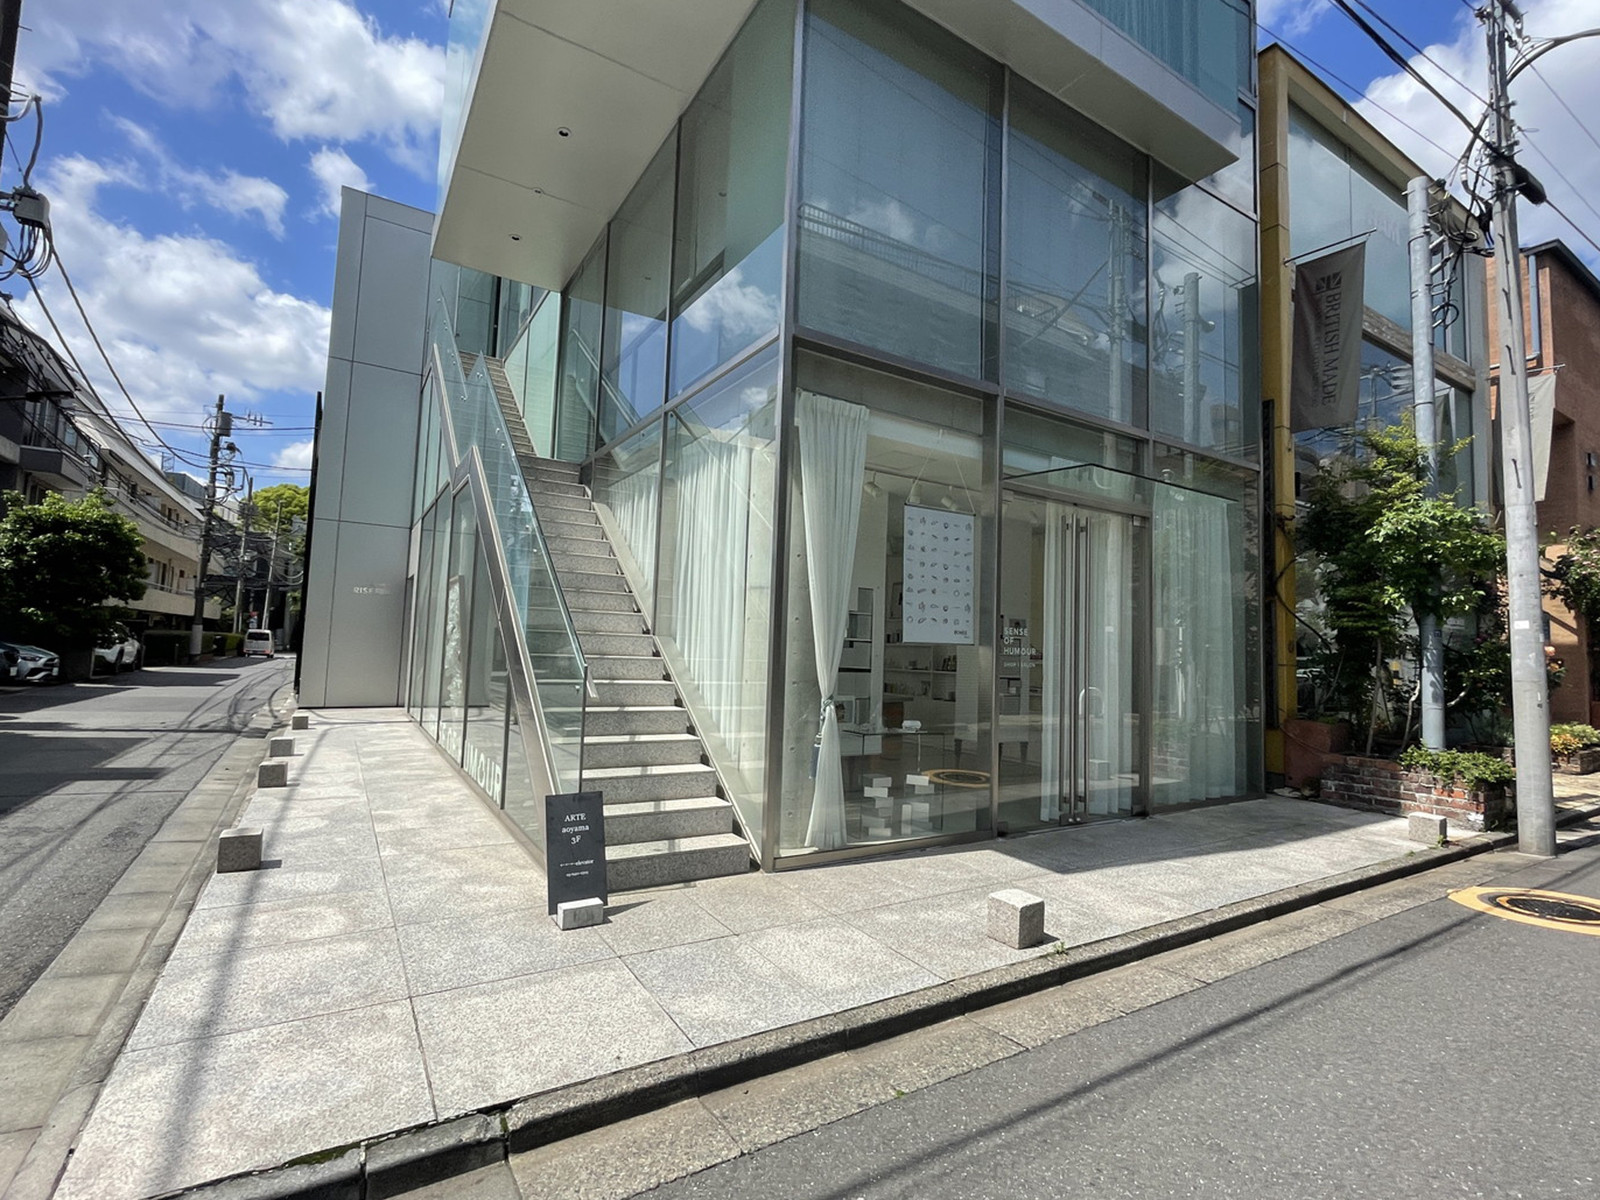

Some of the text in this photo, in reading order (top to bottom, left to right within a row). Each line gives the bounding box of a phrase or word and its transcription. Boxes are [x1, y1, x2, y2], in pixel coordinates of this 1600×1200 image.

[1321, 293, 1342, 407] BRITISH MADE
[1003, 627, 1028, 636] SENSE
[1003, 637, 1014, 645] OF
[1003, 647, 1036, 656] HUMOUR
[564, 813, 586, 822] ARTE
[561, 825, 589, 834] aoyama
[571, 835, 581, 844] 3F
